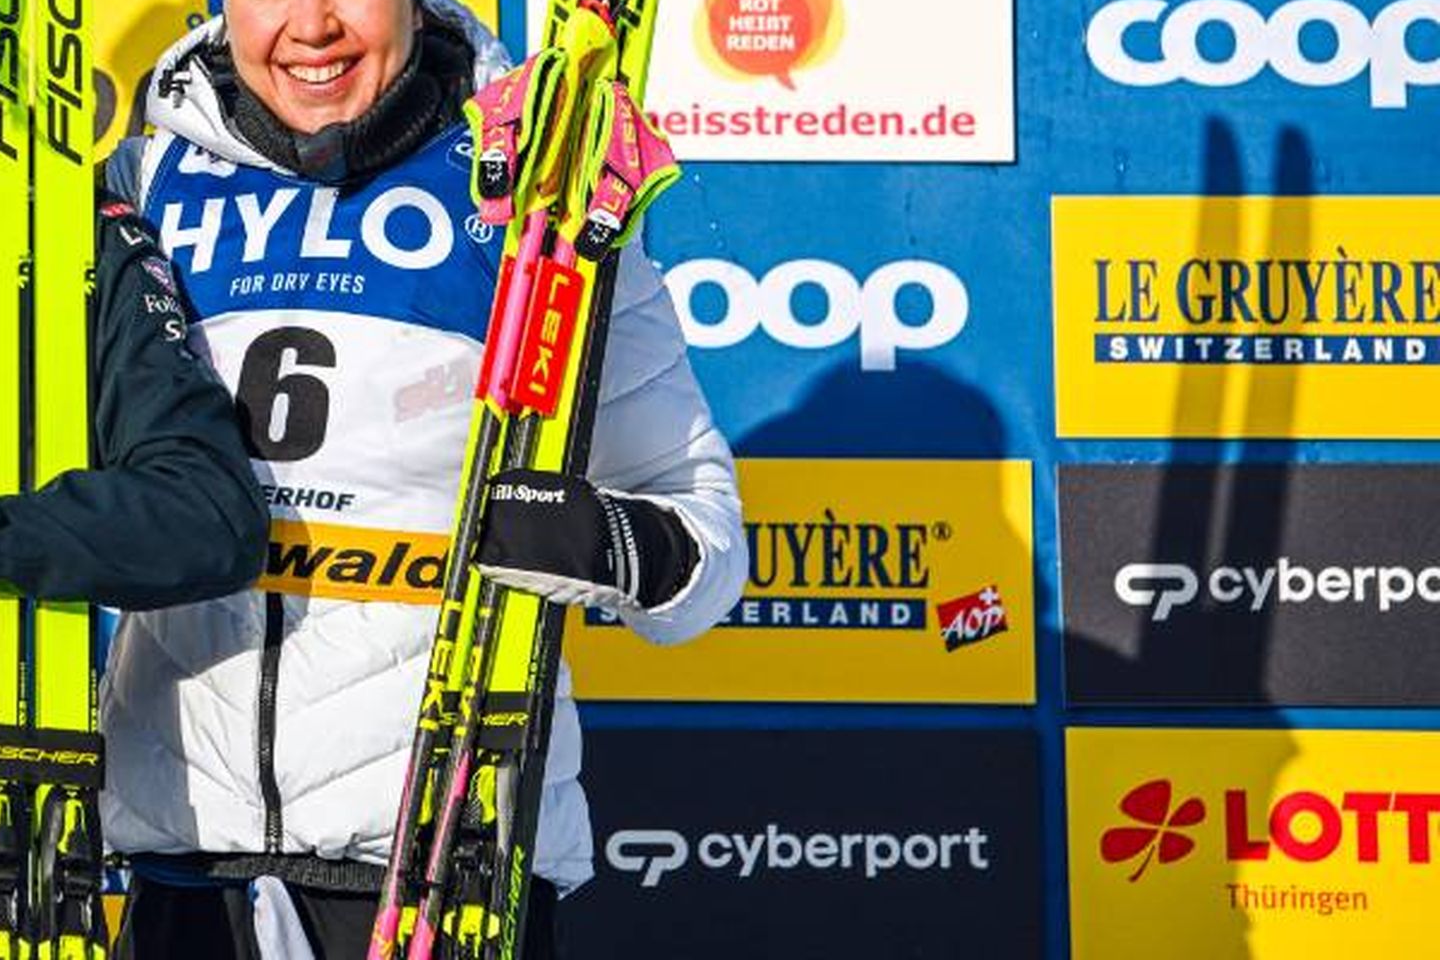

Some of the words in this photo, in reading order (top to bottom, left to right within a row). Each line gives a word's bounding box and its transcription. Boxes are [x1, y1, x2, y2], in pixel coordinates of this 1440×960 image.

[727, 34, 795, 51] REDEN
[230, 275, 266, 297] FOR
[271, 273, 309, 294] DRY
[316, 273, 365, 295] EYES
[1094, 260, 1160, 323] LE
[660, 257, 968, 371] oop
[1109, 336, 1428, 362] SWITZERLAND
[237, 326, 336, 462] 6
[260, 485, 356, 512] ERHOF
[265, 541, 450, 589] wald
[1225, 790, 1440, 863] LOTT
[698, 824, 990, 878] cyberport
[1225, 882, 1368, 915] Thüringen
